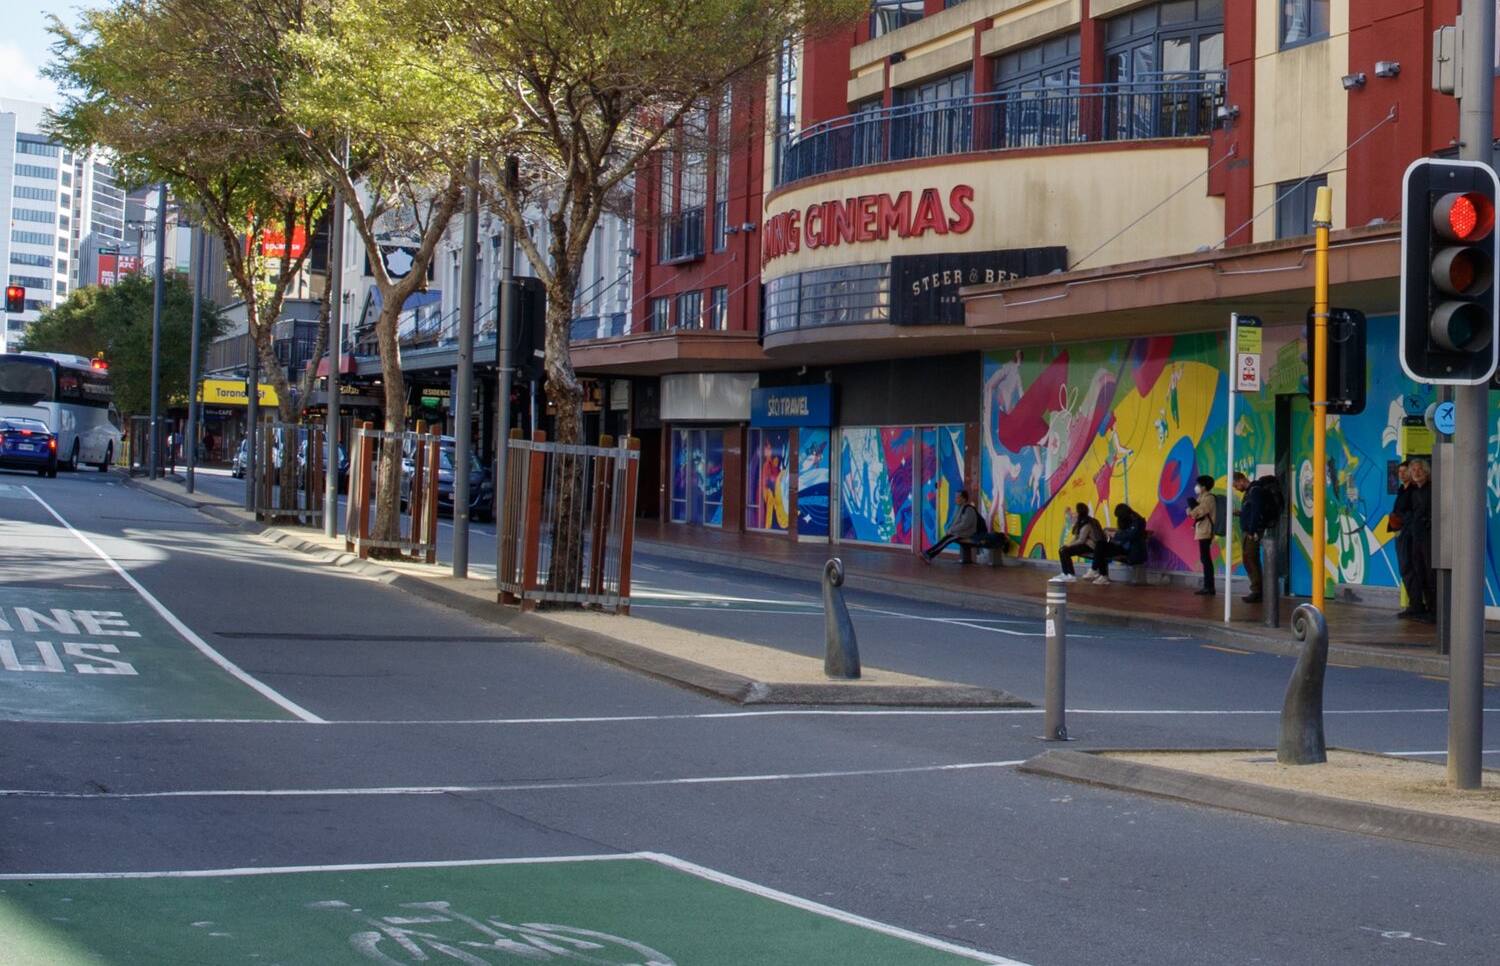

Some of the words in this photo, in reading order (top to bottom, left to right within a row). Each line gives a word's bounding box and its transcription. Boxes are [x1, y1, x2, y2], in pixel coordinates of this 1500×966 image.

[805, 184, 974, 249] CINEMAS
[912, 270, 962, 296] STEER
[969, 268, 978, 283] &
[781, 395, 809, 415] TRAVEL
